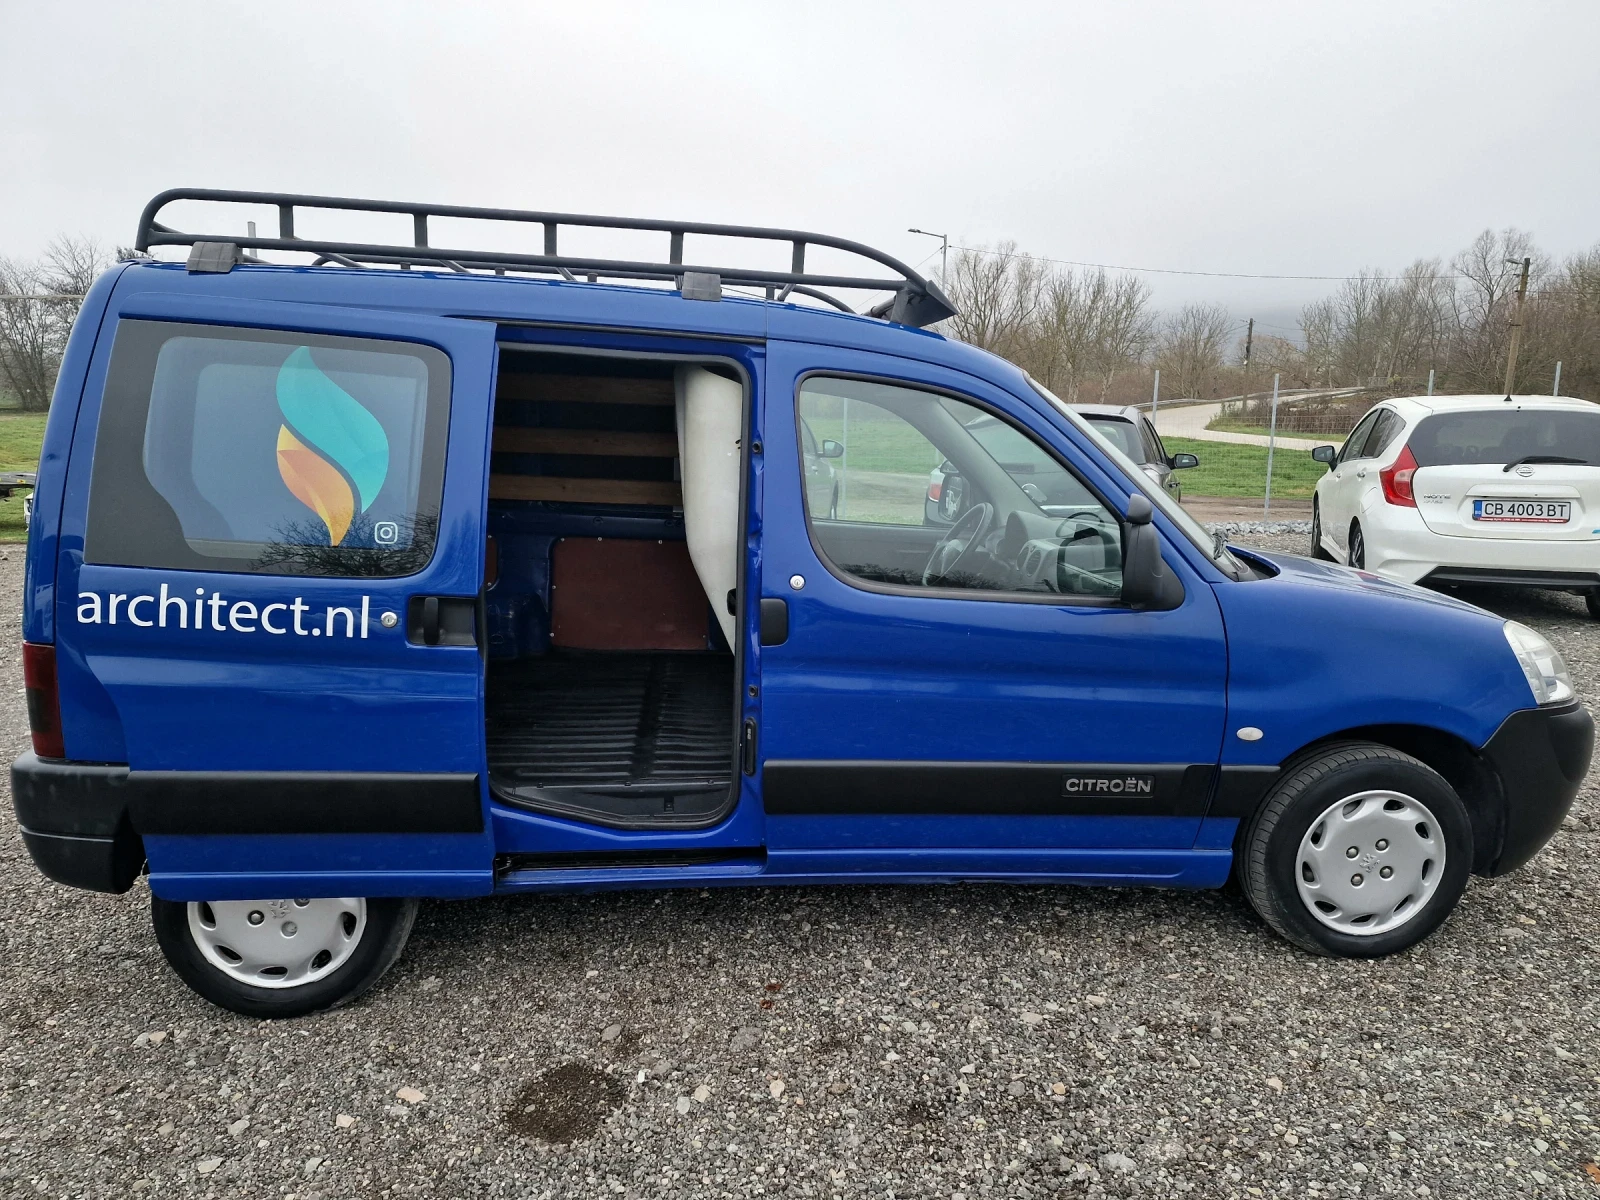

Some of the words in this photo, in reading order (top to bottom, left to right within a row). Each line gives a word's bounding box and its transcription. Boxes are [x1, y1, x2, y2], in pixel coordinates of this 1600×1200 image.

[1484, 502, 1504, 516] CB
[1507, 503, 1544, 516] 4003
[1547, 504, 1567, 517] BT
[77, 583, 369, 639] architect.nl
[1065, 777, 1152, 793] CITROËN
